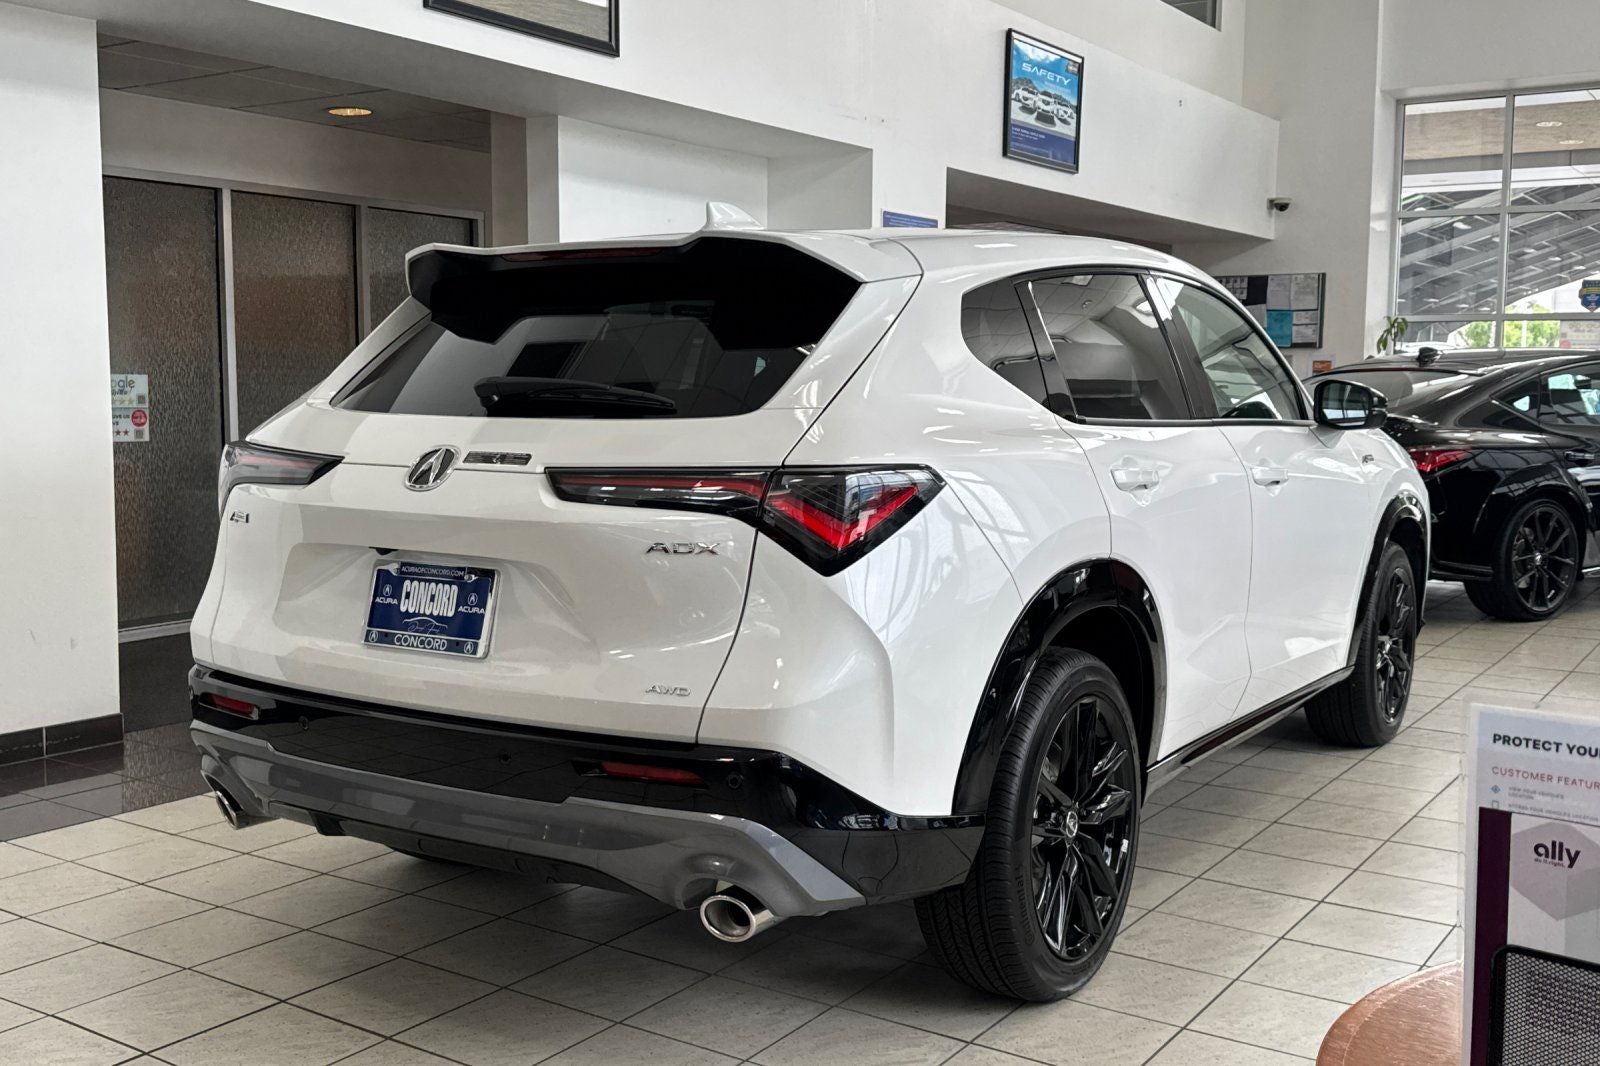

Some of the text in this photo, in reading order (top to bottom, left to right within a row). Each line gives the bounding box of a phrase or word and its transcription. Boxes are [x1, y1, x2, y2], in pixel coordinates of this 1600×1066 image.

[1021, 62, 1072, 86] SAFETY
[645, 542, 721, 555] ADX
[374, 596, 398, 605] ACURA
[400, 579, 459, 617] CONCORD
[457, 605, 486, 615] ACURA
[394, 633, 448, 651] CONCORD
[645, 684, 691, 697] AWD
[1492, 733, 1600, 759] PROTECT YOU
[1491, 766, 1553, 783] CUSTOMER
[1533, 840, 1582, 869] ally
